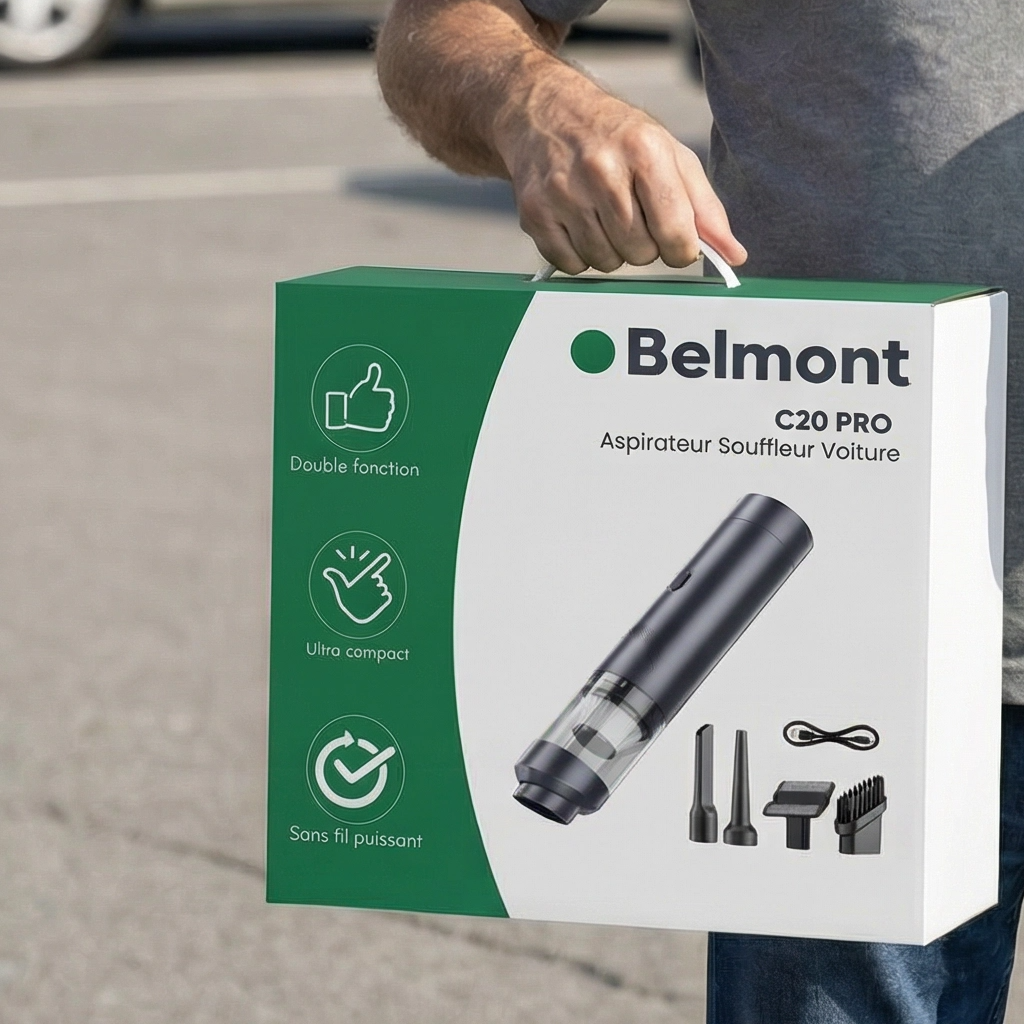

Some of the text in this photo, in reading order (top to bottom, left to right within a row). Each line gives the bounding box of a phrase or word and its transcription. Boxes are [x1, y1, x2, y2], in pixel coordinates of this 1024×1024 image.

[627, 327, 910, 387] Belmont
[774, 409, 893, 434] C20 PRO
[600, 432, 901, 462] Aspirateur Souffleur Voiture
[290, 456, 420, 477] Double fonction
[306, 641, 410, 663] Ultra compact
[289, 825, 423, 849] Sans fil puissant
